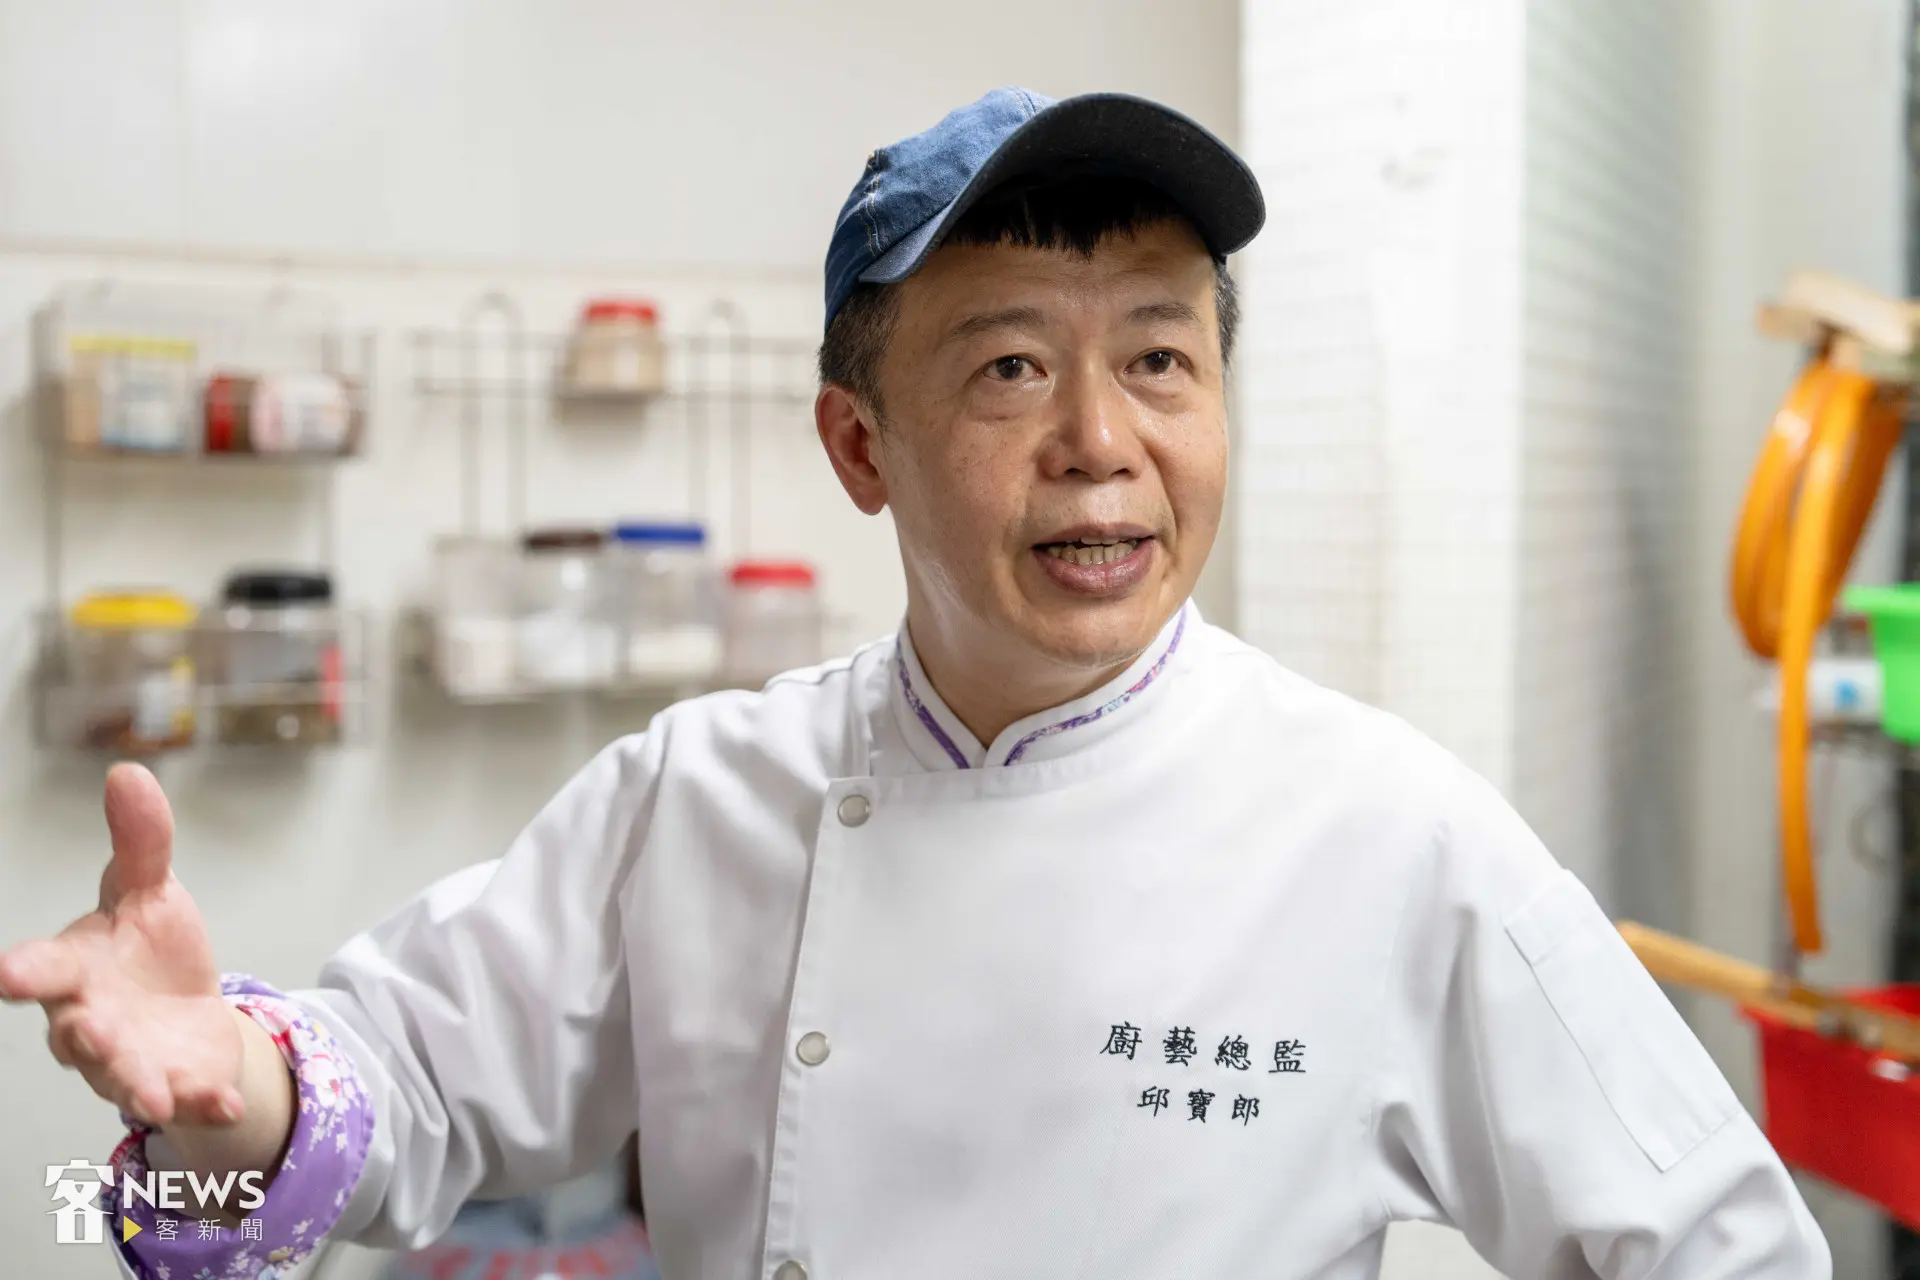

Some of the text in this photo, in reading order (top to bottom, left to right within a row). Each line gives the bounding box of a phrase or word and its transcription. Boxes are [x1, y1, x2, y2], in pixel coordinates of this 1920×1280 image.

[1100, 1021, 1307, 1074] 廚藝總監
[1136, 1085, 1260, 1126] 邱寶郎
